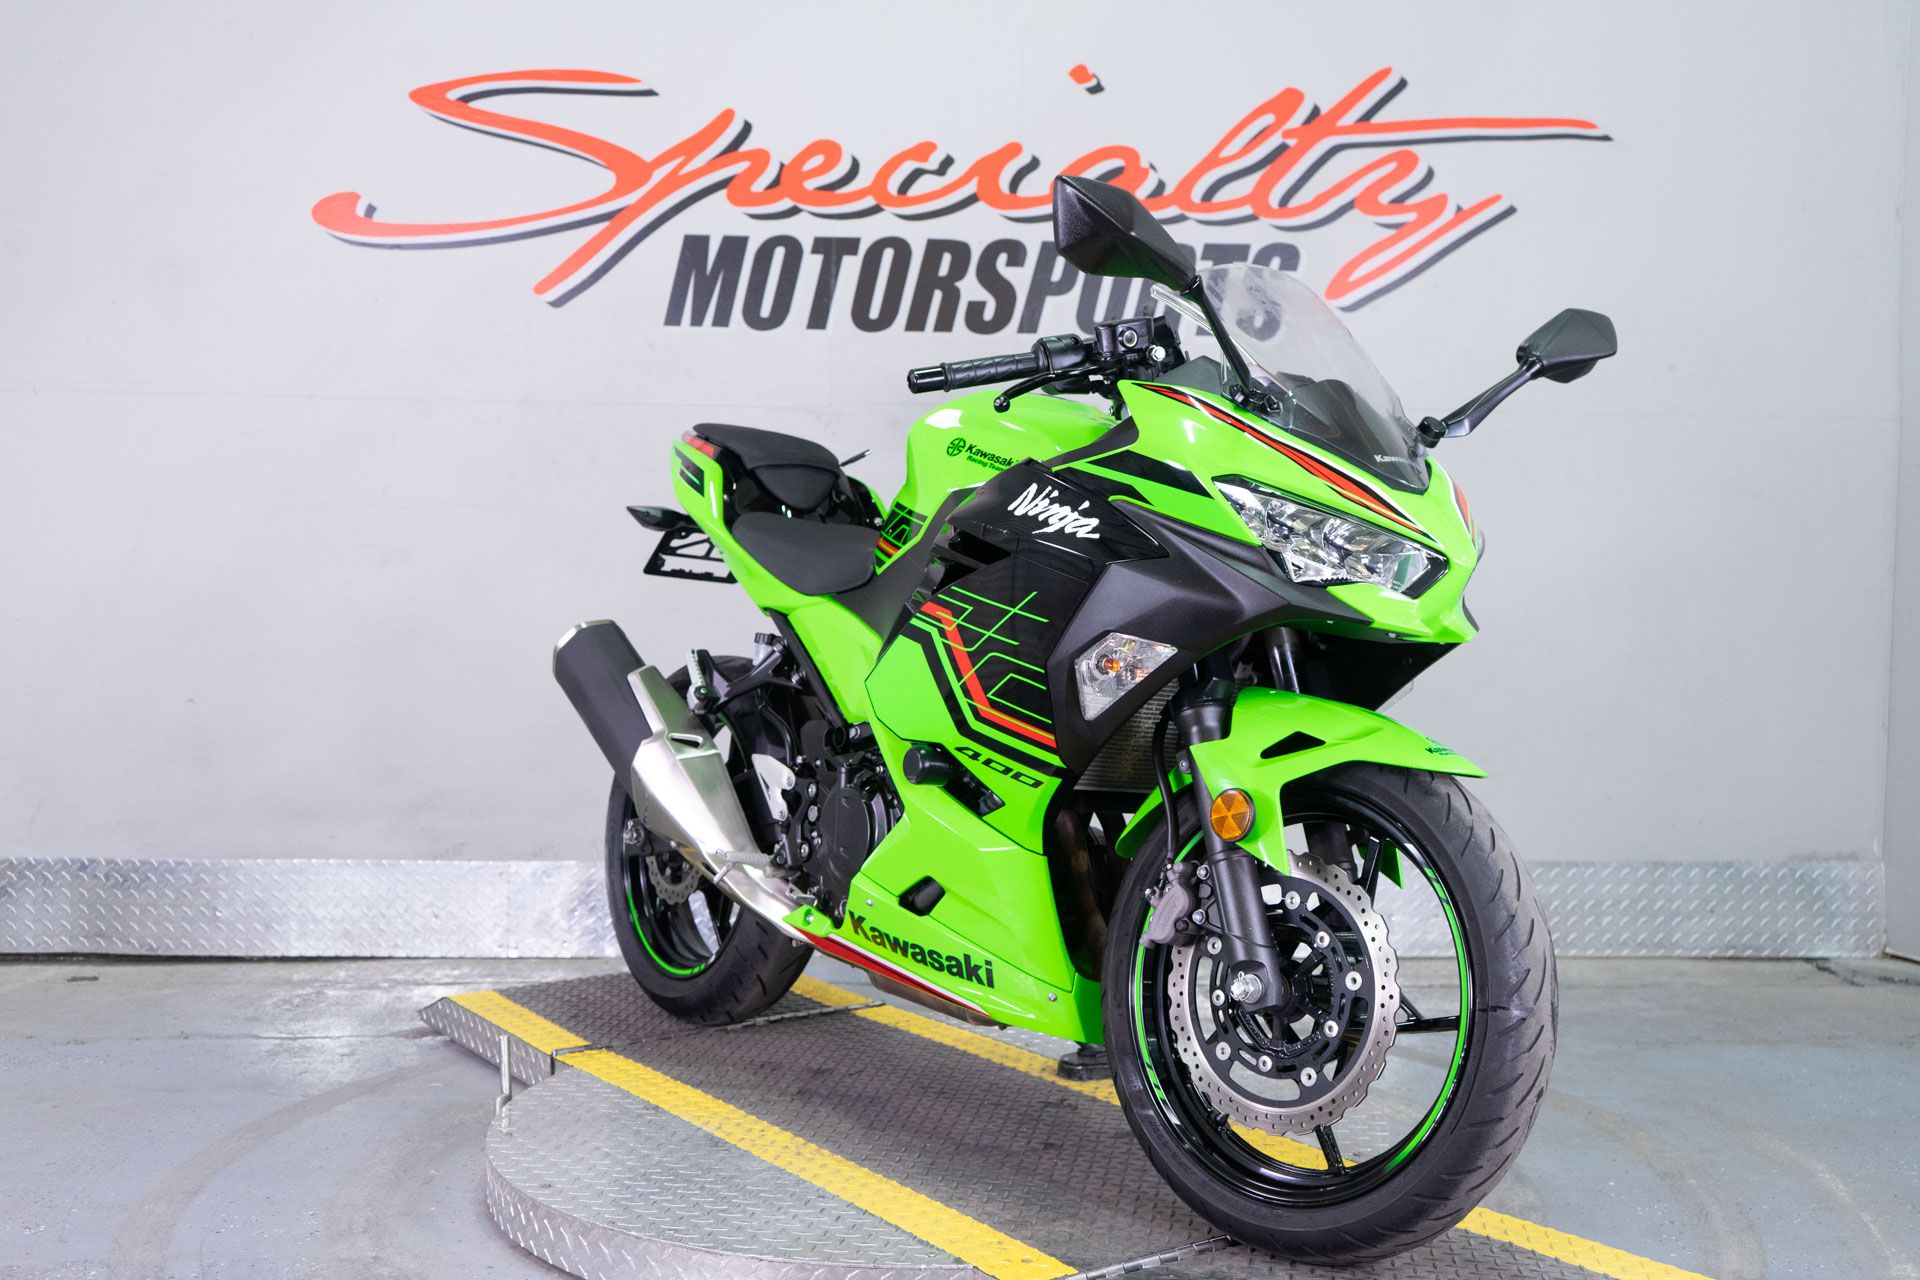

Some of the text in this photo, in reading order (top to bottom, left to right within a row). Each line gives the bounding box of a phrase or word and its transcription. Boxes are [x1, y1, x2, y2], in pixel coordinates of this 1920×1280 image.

[311, 66, 1615, 308] Specialty
[1007, 482, 1101, 540] Ninja
[953, 746, 1045, 789] 400
[848, 909, 996, 990] Kawasaki
